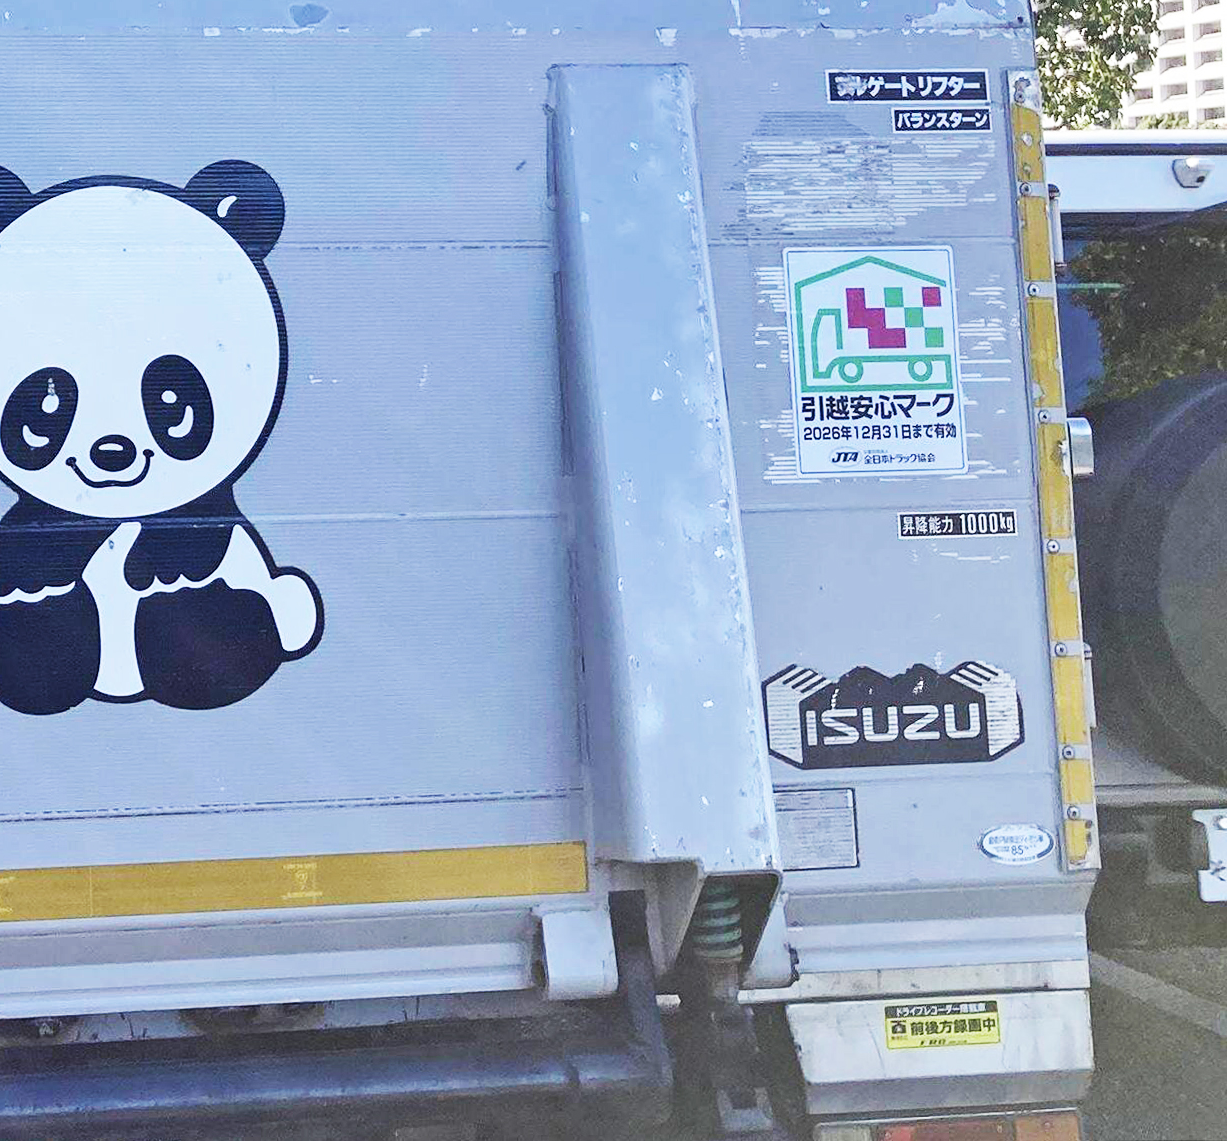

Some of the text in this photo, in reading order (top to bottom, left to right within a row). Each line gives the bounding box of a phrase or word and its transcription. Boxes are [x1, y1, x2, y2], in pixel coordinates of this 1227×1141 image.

[896, 111, 988, 130] バランスターン
[800, 392, 955, 422] 引越安心マーク
[803, 422, 958, 441] 2026年12月31日まで有効
[805, 702, 982, 747] ISUZU
